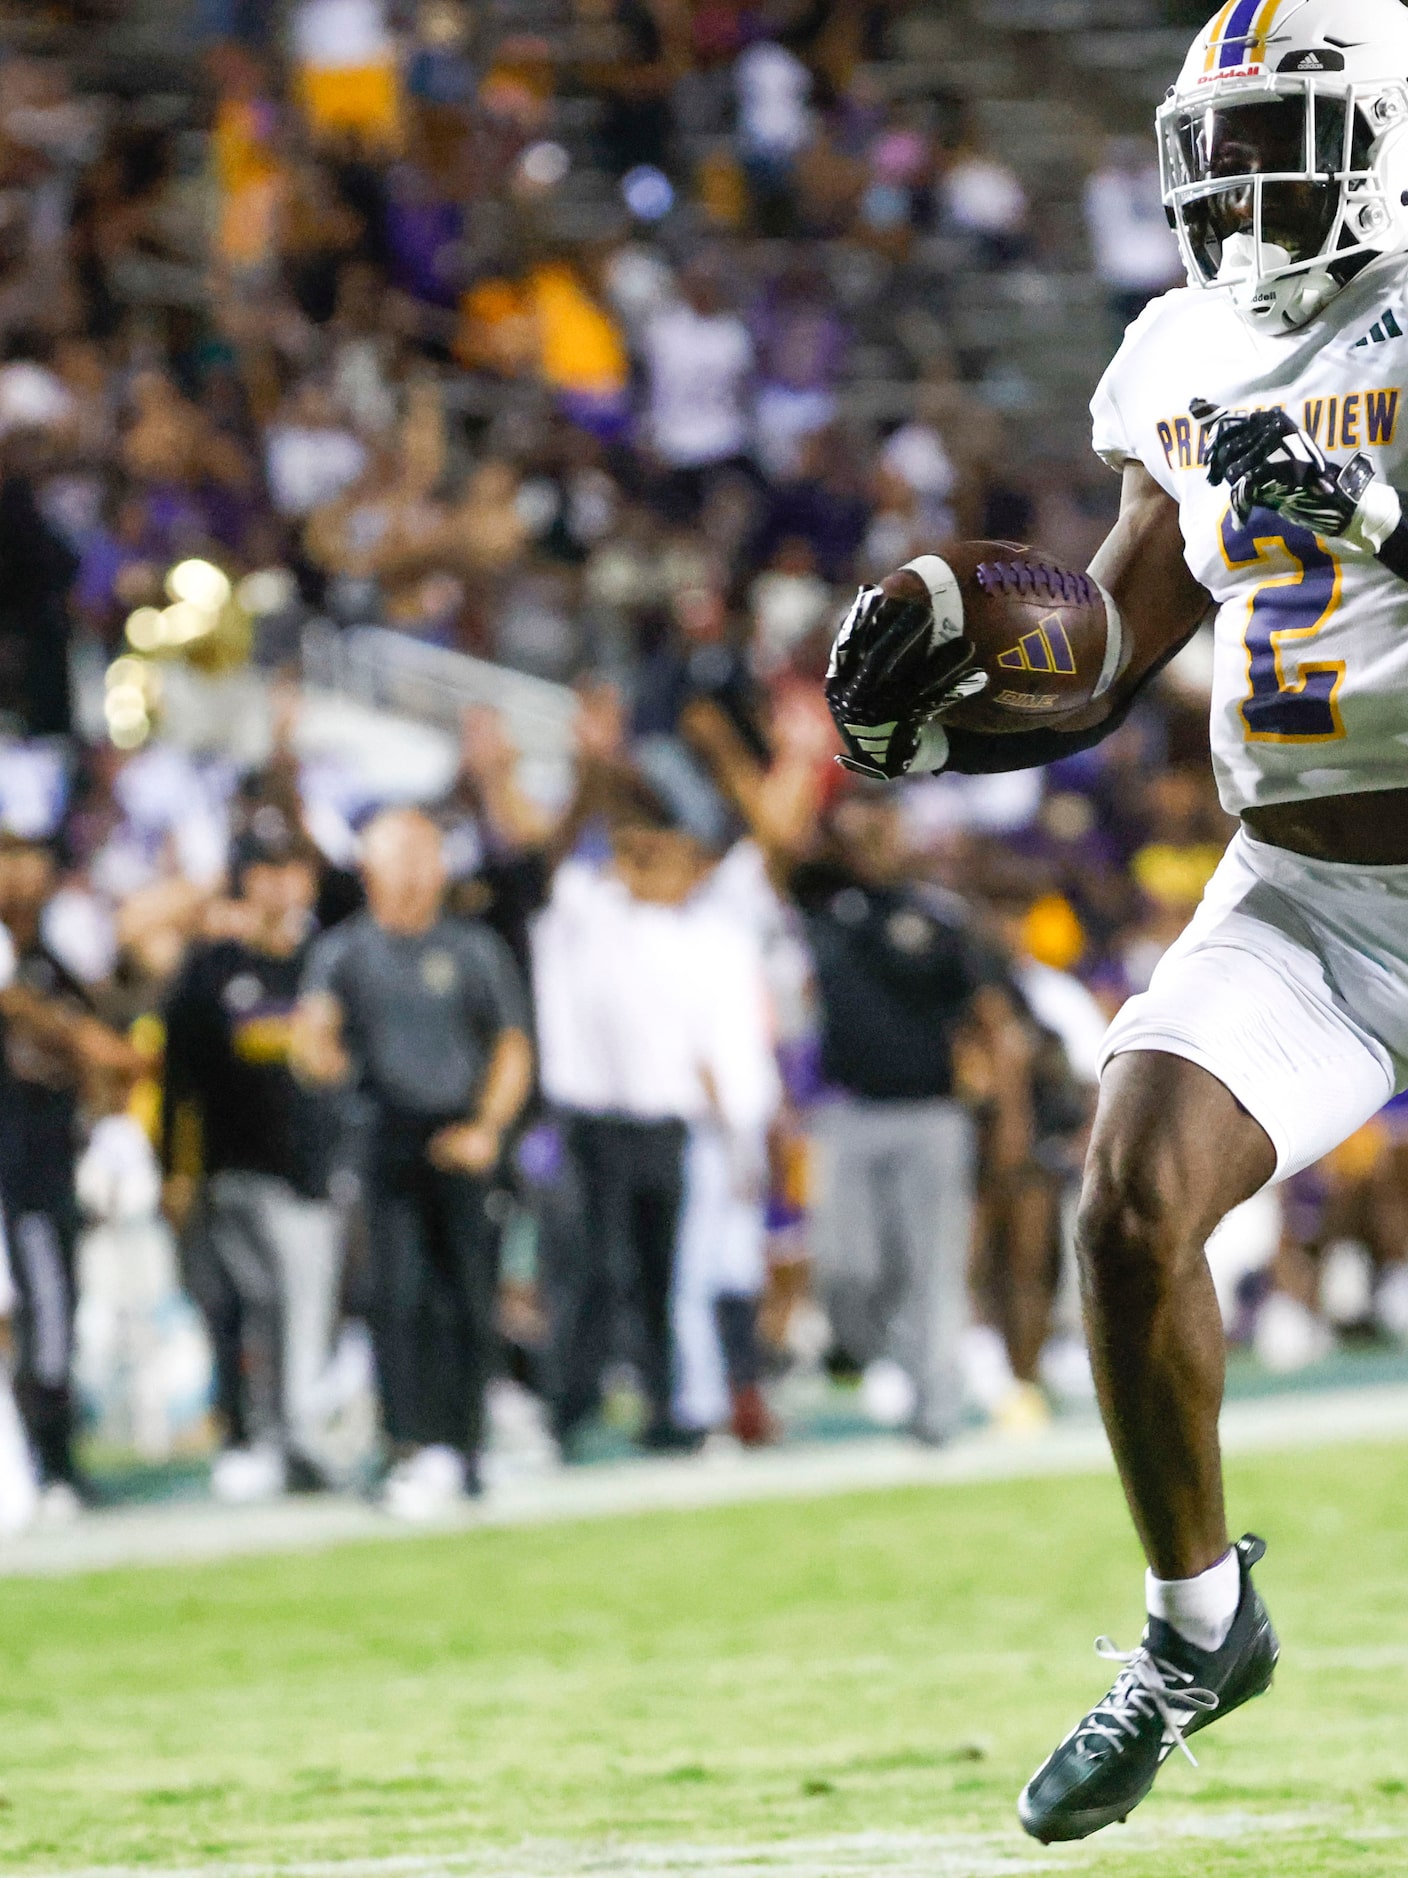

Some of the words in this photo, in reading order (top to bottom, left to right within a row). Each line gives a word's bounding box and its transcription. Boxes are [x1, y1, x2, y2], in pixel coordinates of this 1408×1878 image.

[1252, 291, 1276, 302] ddell
[1304, 388, 1401, 451] VIEW
[1216, 502, 1347, 743] 2
